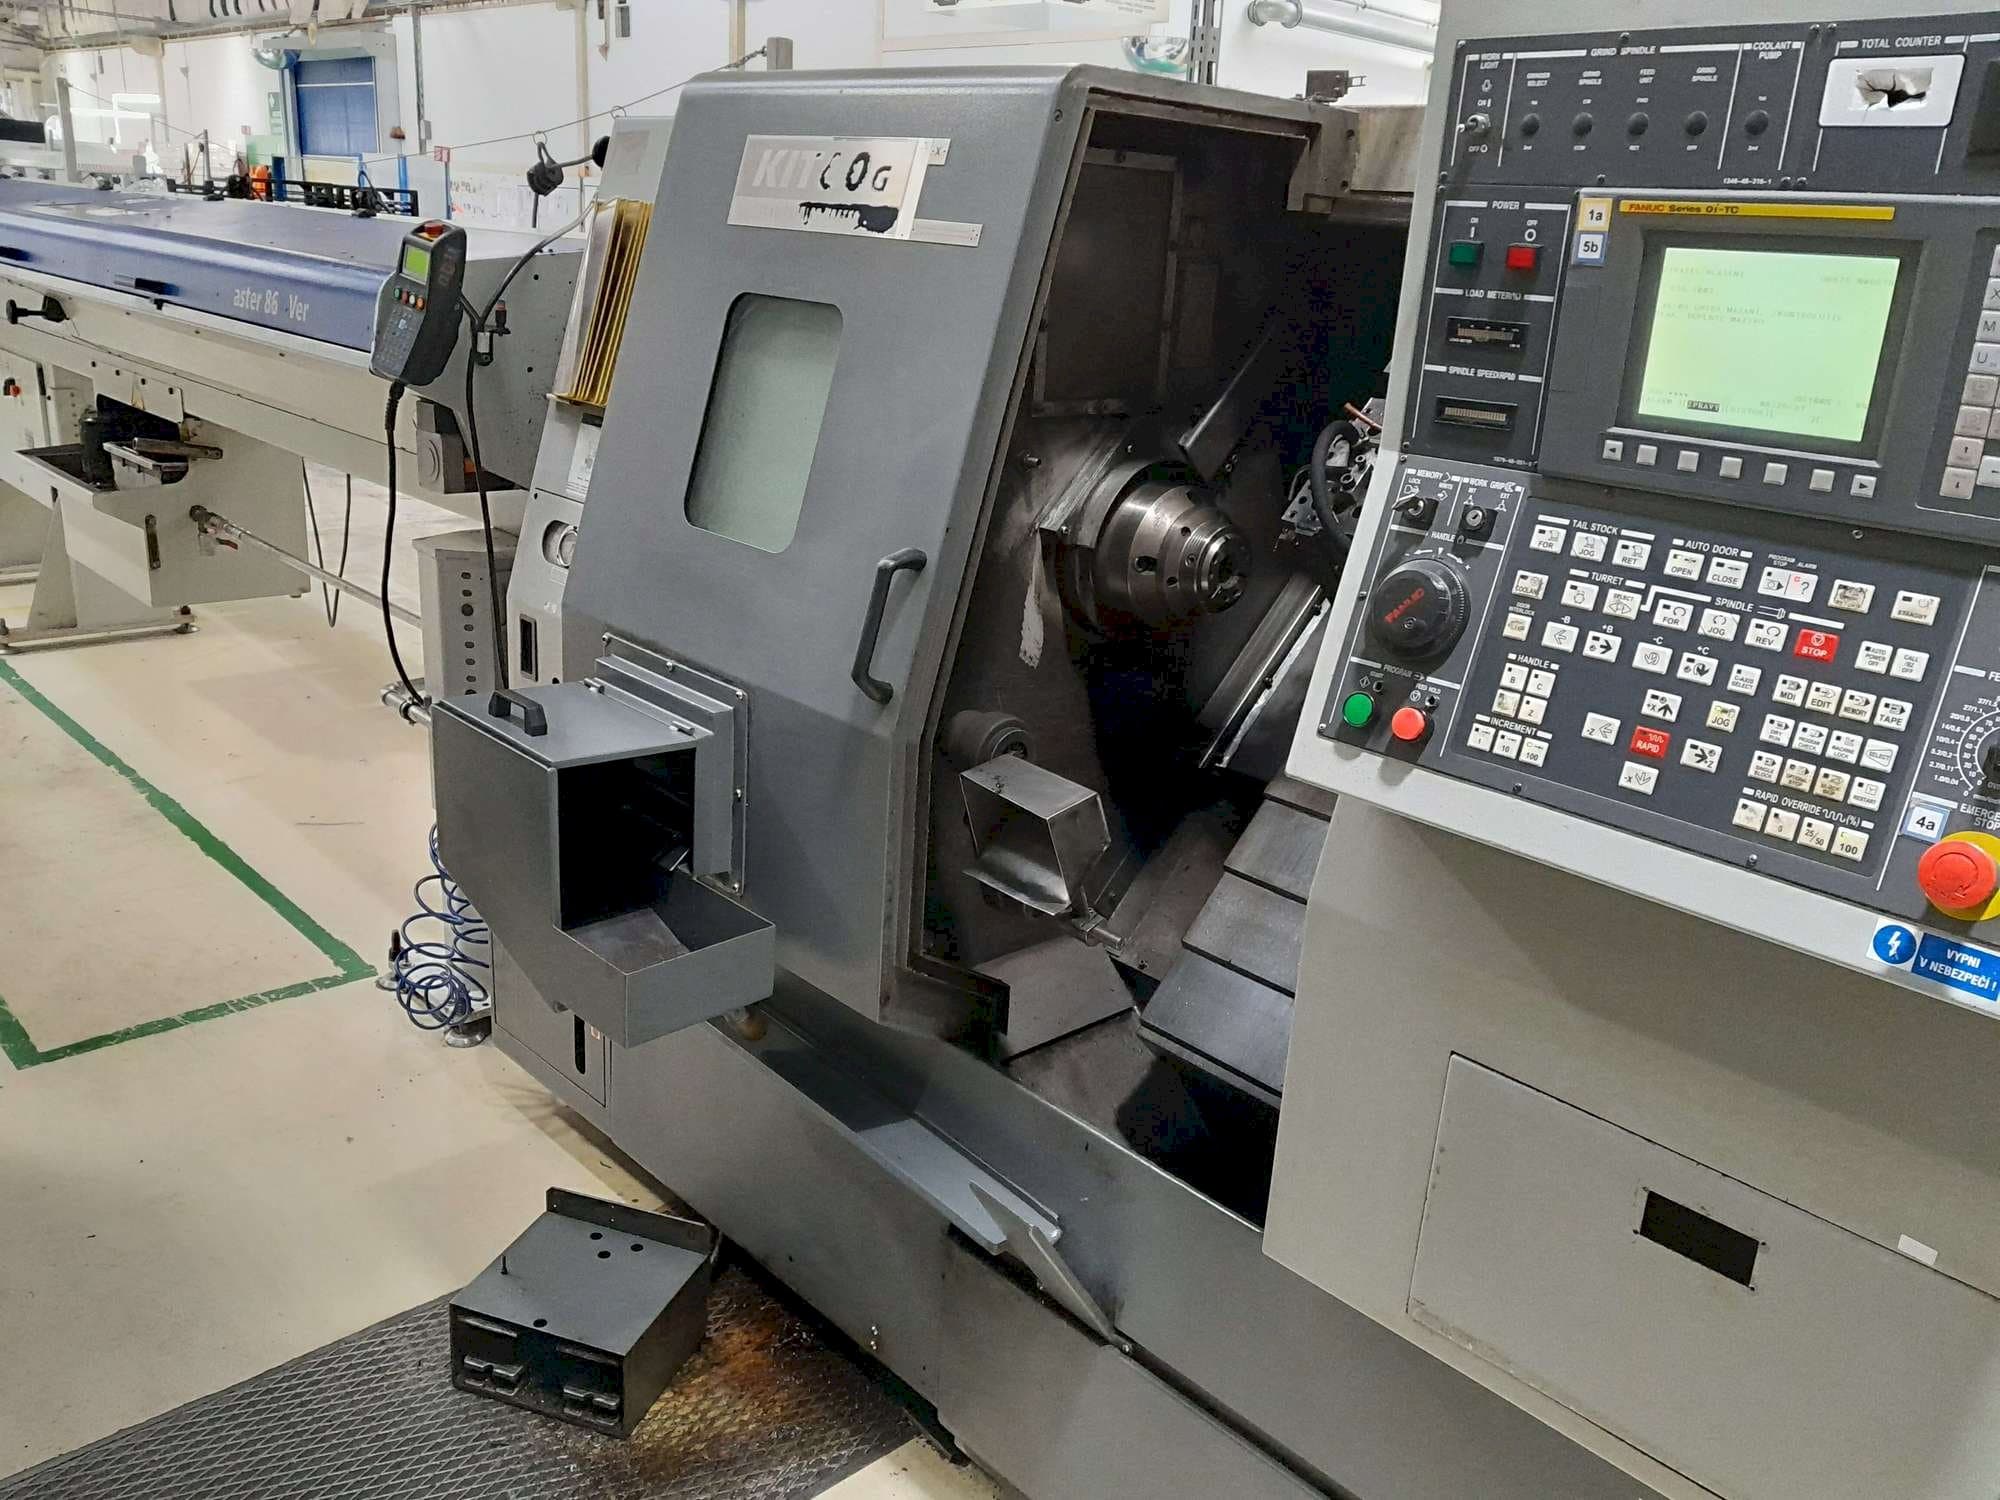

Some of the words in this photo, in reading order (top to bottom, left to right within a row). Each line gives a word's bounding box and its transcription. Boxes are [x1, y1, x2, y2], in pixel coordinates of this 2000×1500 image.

[1752, 41, 1792, 50] COOLANT
[1861, 38, 1890, 48] TOTAL
[1895, 36, 1942, 48] COUNTER
[1620, 46, 1656, 56] SPINDLE
[1758, 51, 1782, 60] PUMP
[1492, 202, 1520, 210] POWER
[1628, 204, 1665, 212] FANUC
[1668, 204, 1701, 213] Series
[1588, 209, 1602, 222] 1a
[1582, 241, 1598, 253] 5b
[1465, 289, 1484, 298] LOAD
[232, 287, 262, 312] aster
[264, 290, 280, 315] 86
[288, 294, 310, 322] Ver
[1982, 320, 1996, 332] M
[1976, 352, 1989, 364] U
[1448, 366, 1475, 376] SPINDLE
[1417, 470, 1443, 480] MEMORY
[1572, 520, 1590, 530] TAIL
[1590, 523, 1619, 536] STOCK
[1431, 532, 1456, 542] HANDLE
[1538, 542, 1554, 550] FOR
[1685, 540, 1710, 552] AUTO
[1712, 544, 1739, 556] DOOR
[1578, 549, 1594, 558] JOG
[1621, 557, 1637, 565] RET
[1671, 566, 1692, 576] OPEN
[1591, 572, 1624, 586] TURRET
[1712, 575, 1738, 585] CLOSE
[1715, 597, 1754, 612] SPINDLE
[1662, 616, 1680, 626] FOR
[1602, 624, 1614, 634] +B
[1707, 627, 1726, 636] JOG
[1652, 636, 1664, 645] -C
[1755, 636, 1776, 646] REV
[1697, 646, 1710, 655] +C
[1801, 647, 1828, 657] STOP
[1517, 655, 1550, 668] HANDLE
[1510, 676, 1516, 684] B
[1536, 682, 1543, 690] C
[1779, 691, 1796, 701] MDI
[1647, 702, 1656, 712] +X
[1810, 699, 1832, 709] EDIT
[1844, 706, 1868, 717] MEMORY
[1712, 718, 1730, 728] JOG
[1880, 714, 1903, 726] TAPE
[1490, 718, 1537, 736] INCREMENT
[1502, 744, 1510, 752] 10
[1636, 740, 1660, 753] RAPID
[1798, 742, 1816, 752] CHECK
[1526, 752, 1539, 761] 100
[1834, 751, 1850, 760] LOCK
[1968, 770, 1976, 778] 10
[1852, 795, 1876, 804] RESTART
[1754, 790, 1778, 804] RAPID
[1781, 797, 1822, 816] OVERRIDE
[1846, 815, 1861, 828] (%)
[1960, 803, 2000, 822] EMERGE
[1916, 816, 1936, 830] 4a
[1974, 818, 2000, 830] STOP
[1840, 843, 1858, 855] 100
[1946, 948, 1982, 969] VYPNI
[1920, 955, 1928, 968] V
[1928, 963, 1991, 990] NEBEZPEČÍ
[1992, 981, 1998, 992] !
